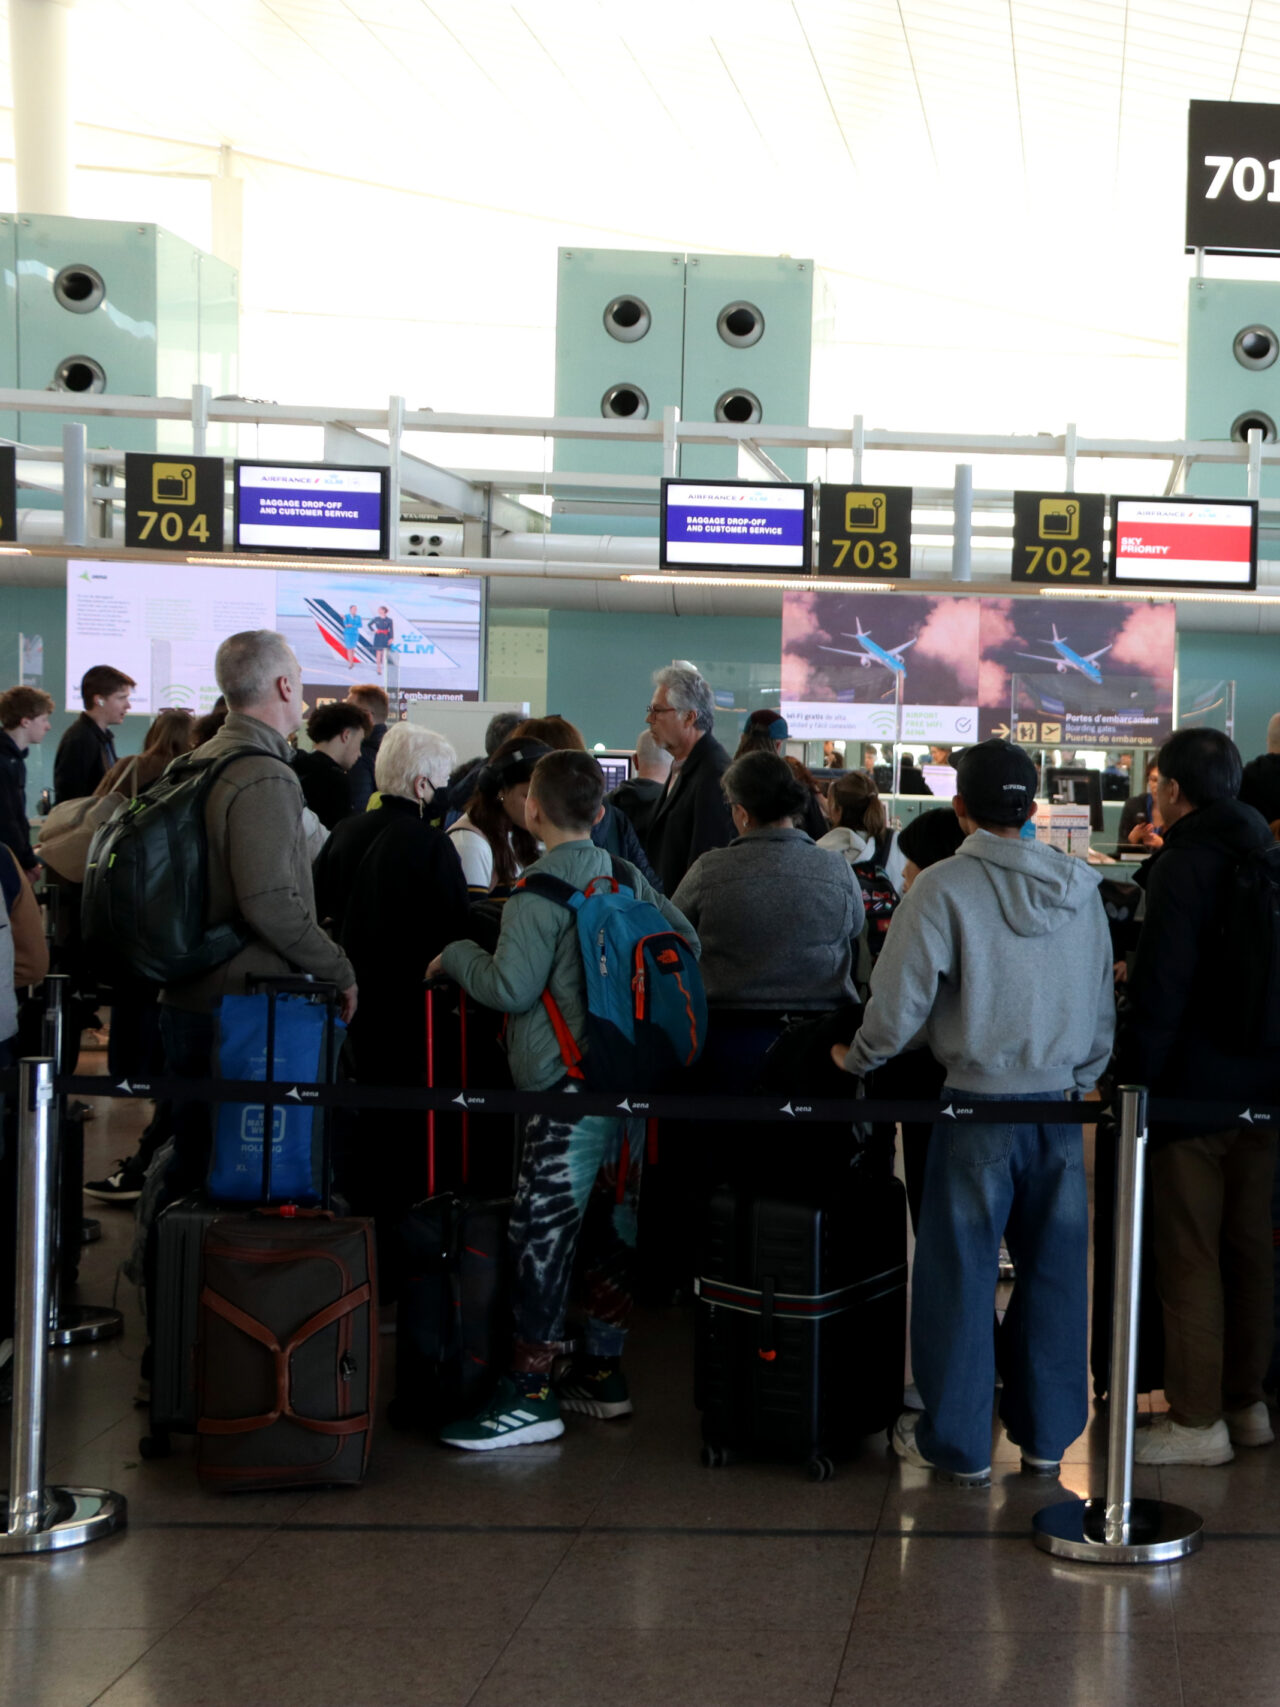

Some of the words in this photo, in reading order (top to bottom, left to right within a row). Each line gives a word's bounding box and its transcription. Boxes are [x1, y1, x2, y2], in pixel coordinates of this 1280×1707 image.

[260, 499, 300, 508] BAGGAGE
[302, 501, 342, 509] DROP-OFF
[260, 507, 277, 515] AND
[279, 508, 323, 517] CUSTOMER
[325, 509, 359, 518] SERVICE
[687, 516, 725, 525] BAGGAGE
[727, 518, 766, 526] DROP-OFF
[137, 511, 210, 543] 704
[705, 526, 748, 534] CUSTOMER
[749, 527, 783, 535] SERVICE
[1121, 537, 1142, 546] SKY
[832, 540, 898, 570] 703
[1121, 545, 1169, 554] PRIORITY
[1025, 546, 1091, 576] 702
[390, 643, 435, 655] KLM
[1066, 713, 1092, 722] Portes
[1094, 714, 1159, 725] d'embarcament
[1065, 734, 1097, 743] Puertas
[1099, 735, 1109, 743] de
[1111, 736, 1153, 745] embarque
